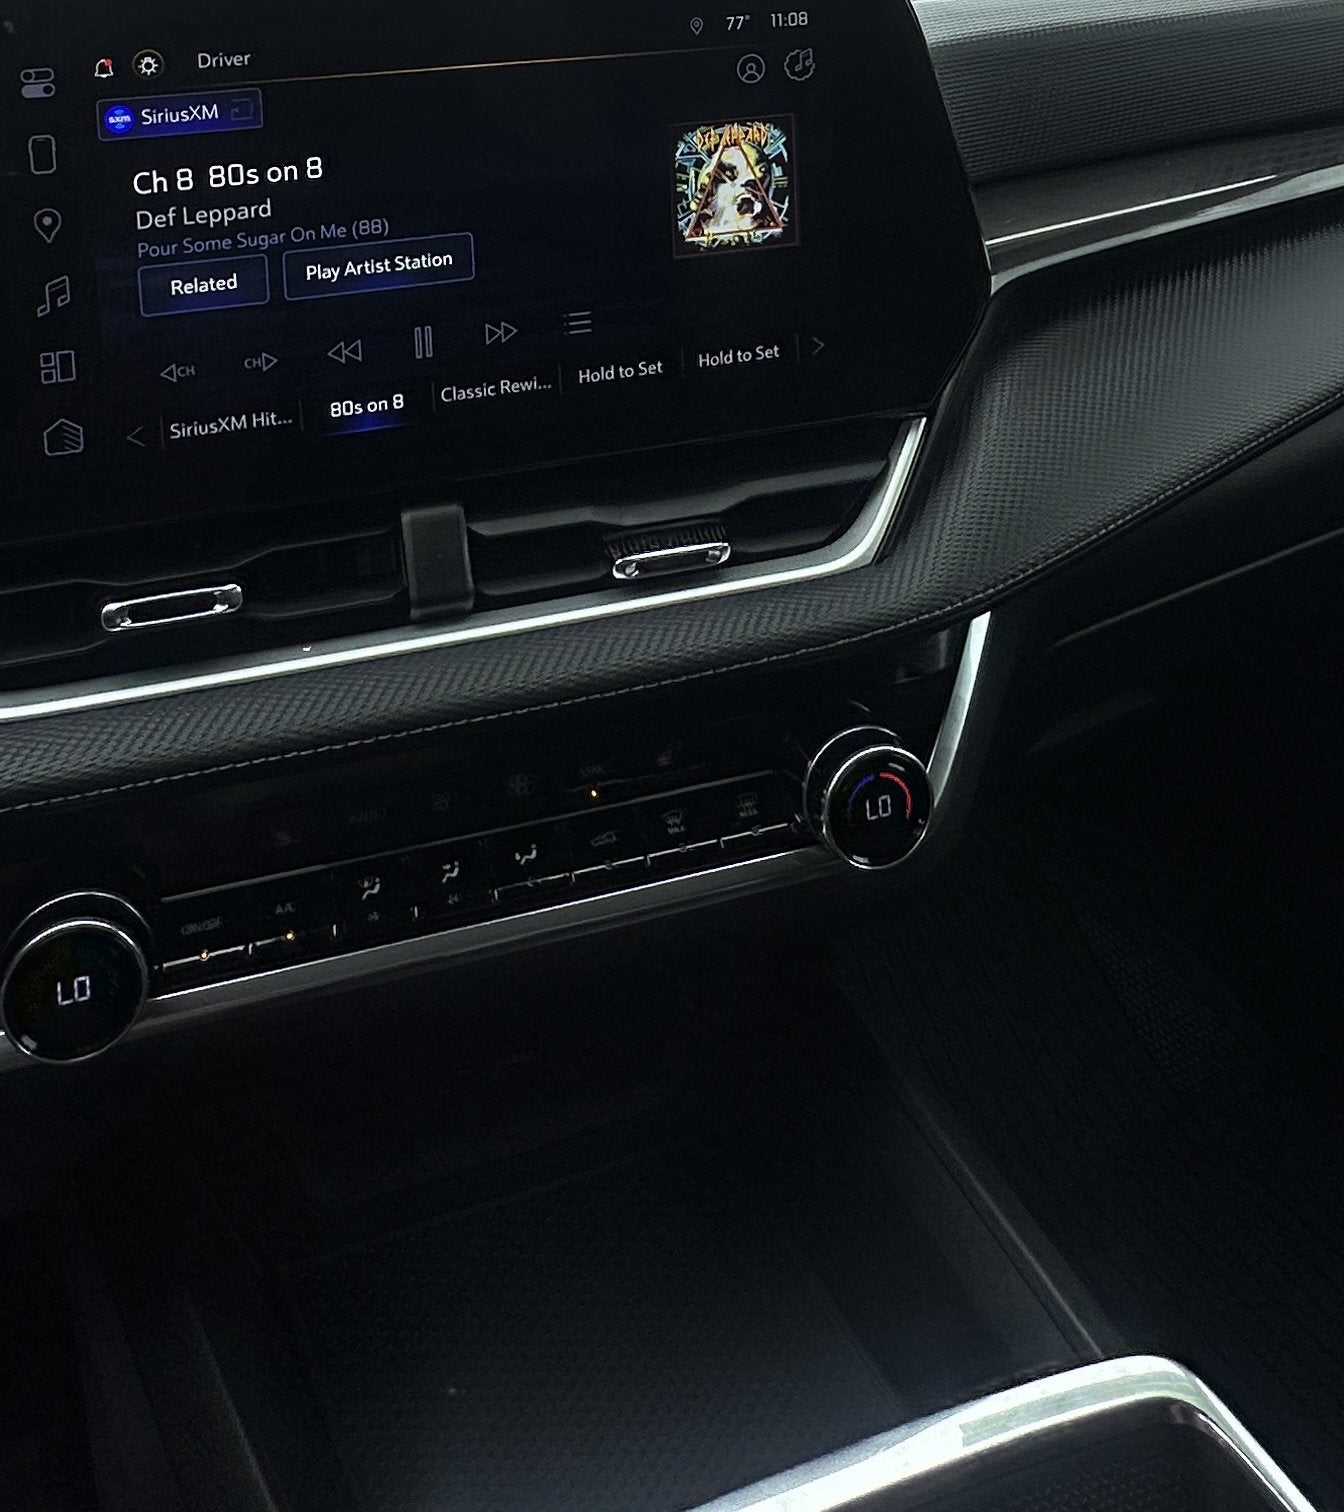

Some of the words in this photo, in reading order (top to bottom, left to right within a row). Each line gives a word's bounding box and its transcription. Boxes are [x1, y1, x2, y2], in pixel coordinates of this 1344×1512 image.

[770, 10, 809, 28] 11:08
[197, 49, 252, 70] Driver
[141, 103, 220, 126] SiriusXM
[132, 169, 169, 195] Ch
[176, 168, 194, 191] 8
[208, 162, 260, 188] 80s
[267, 163, 299, 183] on
[306, 156, 324, 179] 8
[136, 208, 178, 231] Def
[182, 198, 273, 231] Leppard
[137, 238, 178, 259] Pour
[182, 233, 233, 254] Some
[236, 228, 286, 255] Sugar
[290, 225, 317, 243] On
[320, 221, 348, 239] Me
[352, 217, 390, 241] (88)
[305, 262, 340, 284] Play
[344, 256, 392, 278] Artist
[394, 251, 454, 273] Station
[170, 273, 238, 296] Related
[698, 350, 734, 369] Hold
[736, 348, 753, 364] to
[755, 344, 780, 361] Set
[578, 365, 615, 385] Hold
[618, 363, 635, 380] to
[637, 360, 664, 378] Set
[440, 382, 497, 404] Classic
[329, 399, 363, 419] 80s
[367, 399, 389, 415] on
[393, 393, 405, 411] 8
[169, 416, 247, 440] SiriusXM
[866, 794, 893, 822] LO
[56, 974, 92, 1007] LO
